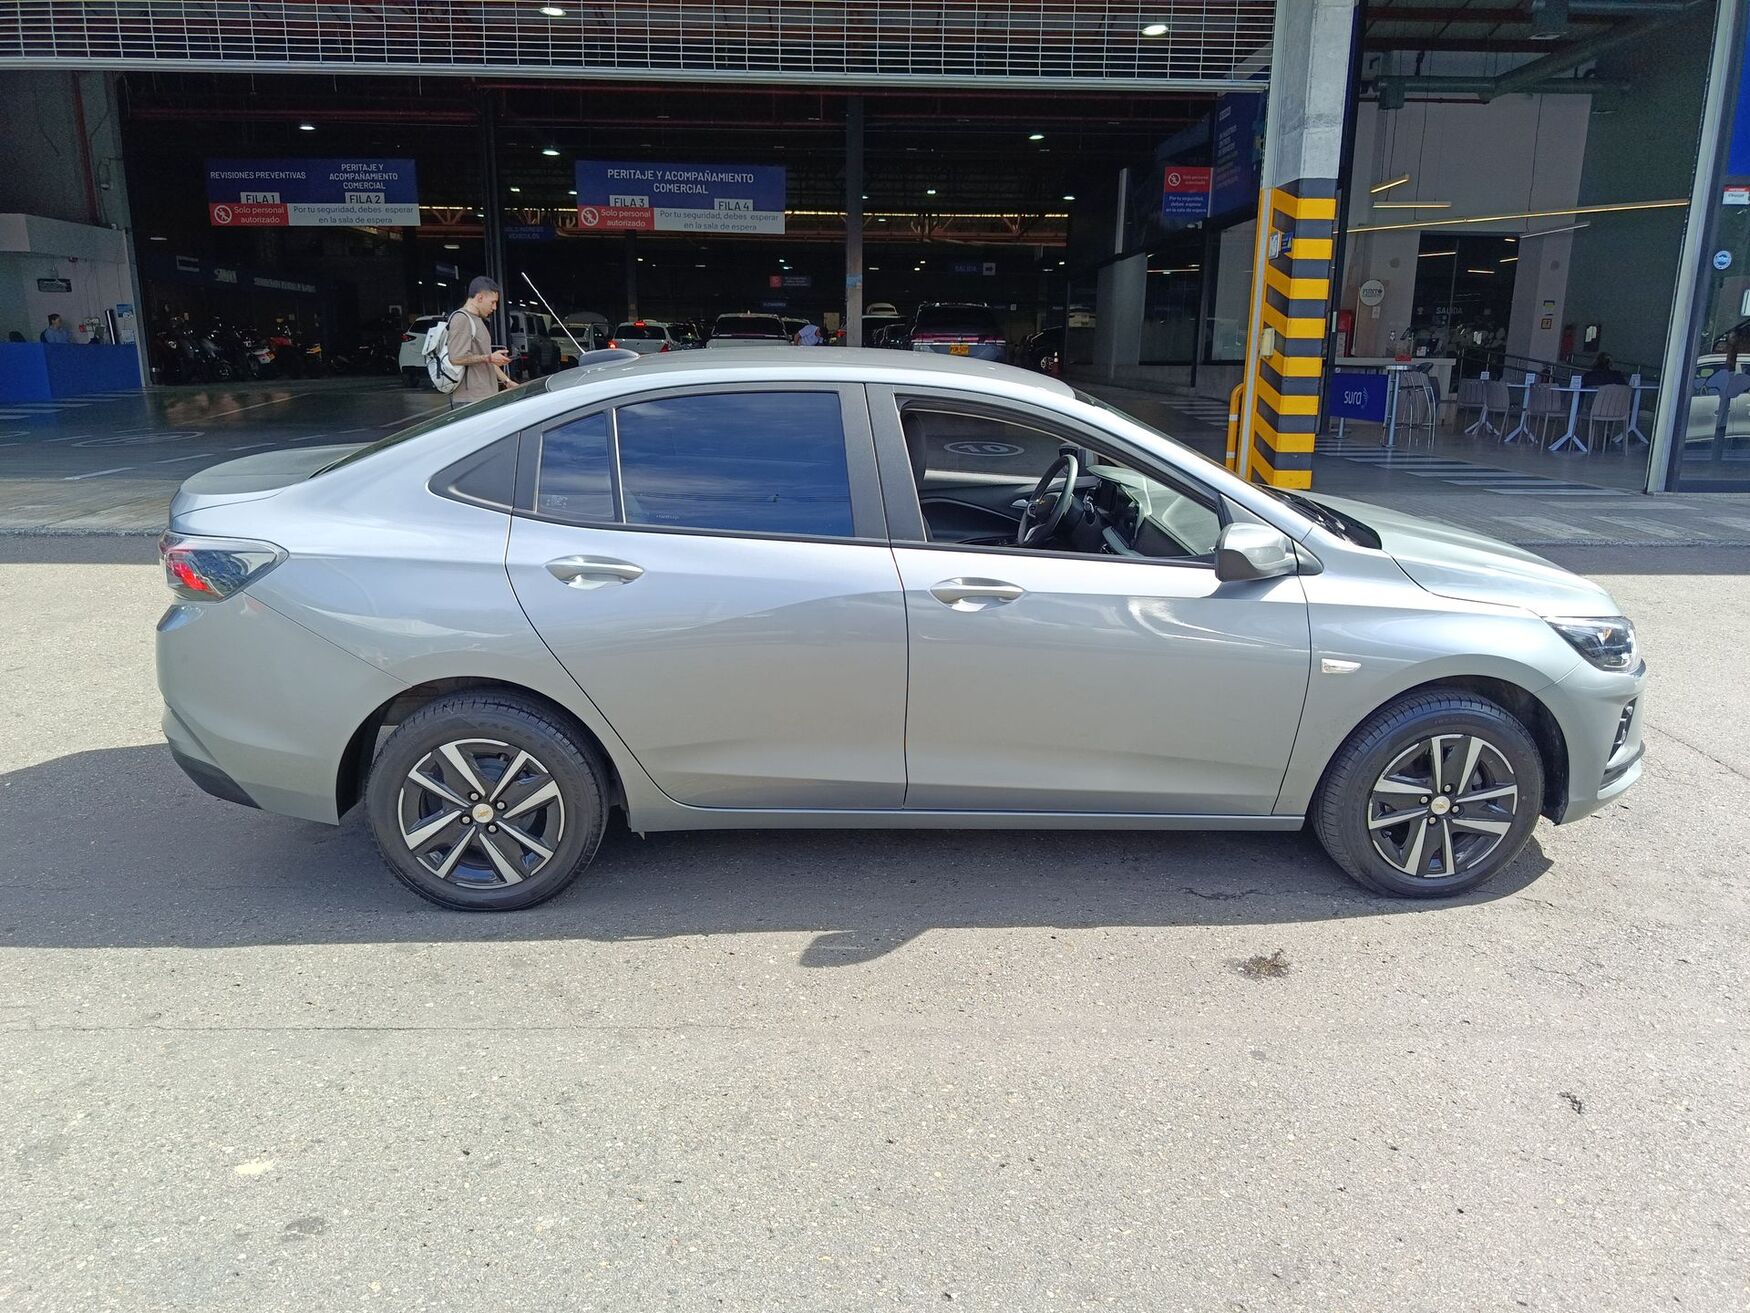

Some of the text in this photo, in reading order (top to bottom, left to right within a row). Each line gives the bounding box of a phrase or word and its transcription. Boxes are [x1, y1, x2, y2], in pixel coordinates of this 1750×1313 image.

[341, 163, 384, 171] PERITAJE Y
[210, 171, 306, 179] REVISIONES PREVENTIVAS
[329, 171, 398, 180] ACOMPAÑAMIENTO
[607, 169, 754, 183] PERITAJE Y ACOMPAÑAMIENTO
[343, 182, 386, 190] COMERCIAL
[653, 183, 709, 194] COMERCIAL
[246, 195, 268, 204] FILA
[349, 195, 381, 204] FILA 2
[614, 198, 645, 207] FILA 3
[718, 201, 749, 211] FILA 4
[234, 206, 284, 216] Solo personal
[293, 206, 307, 214] Por
[308, 206, 316, 214] tu
[358, 206, 381, 214] debes
[385, 207, 413, 216] esperar
[601, 209, 651, 219] Solo personal
[241, 216, 280, 224] autorizado
[330, 216, 338, 224] la
[339, 216, 354, 224] sala
[355, 216, 365, 224] de
[366, 217, 393, 226] espera
[723, 212, 747, 221] debes
[750, 214, 778, 223] esperar
[606, 219, 646, 227] autorizado
[704, 222, 718, 230] sala
[731, 224, 757, 232] espera
[1436, 306, 1463, 314] SALDA
[1343, 391, 1362, 405] sura
